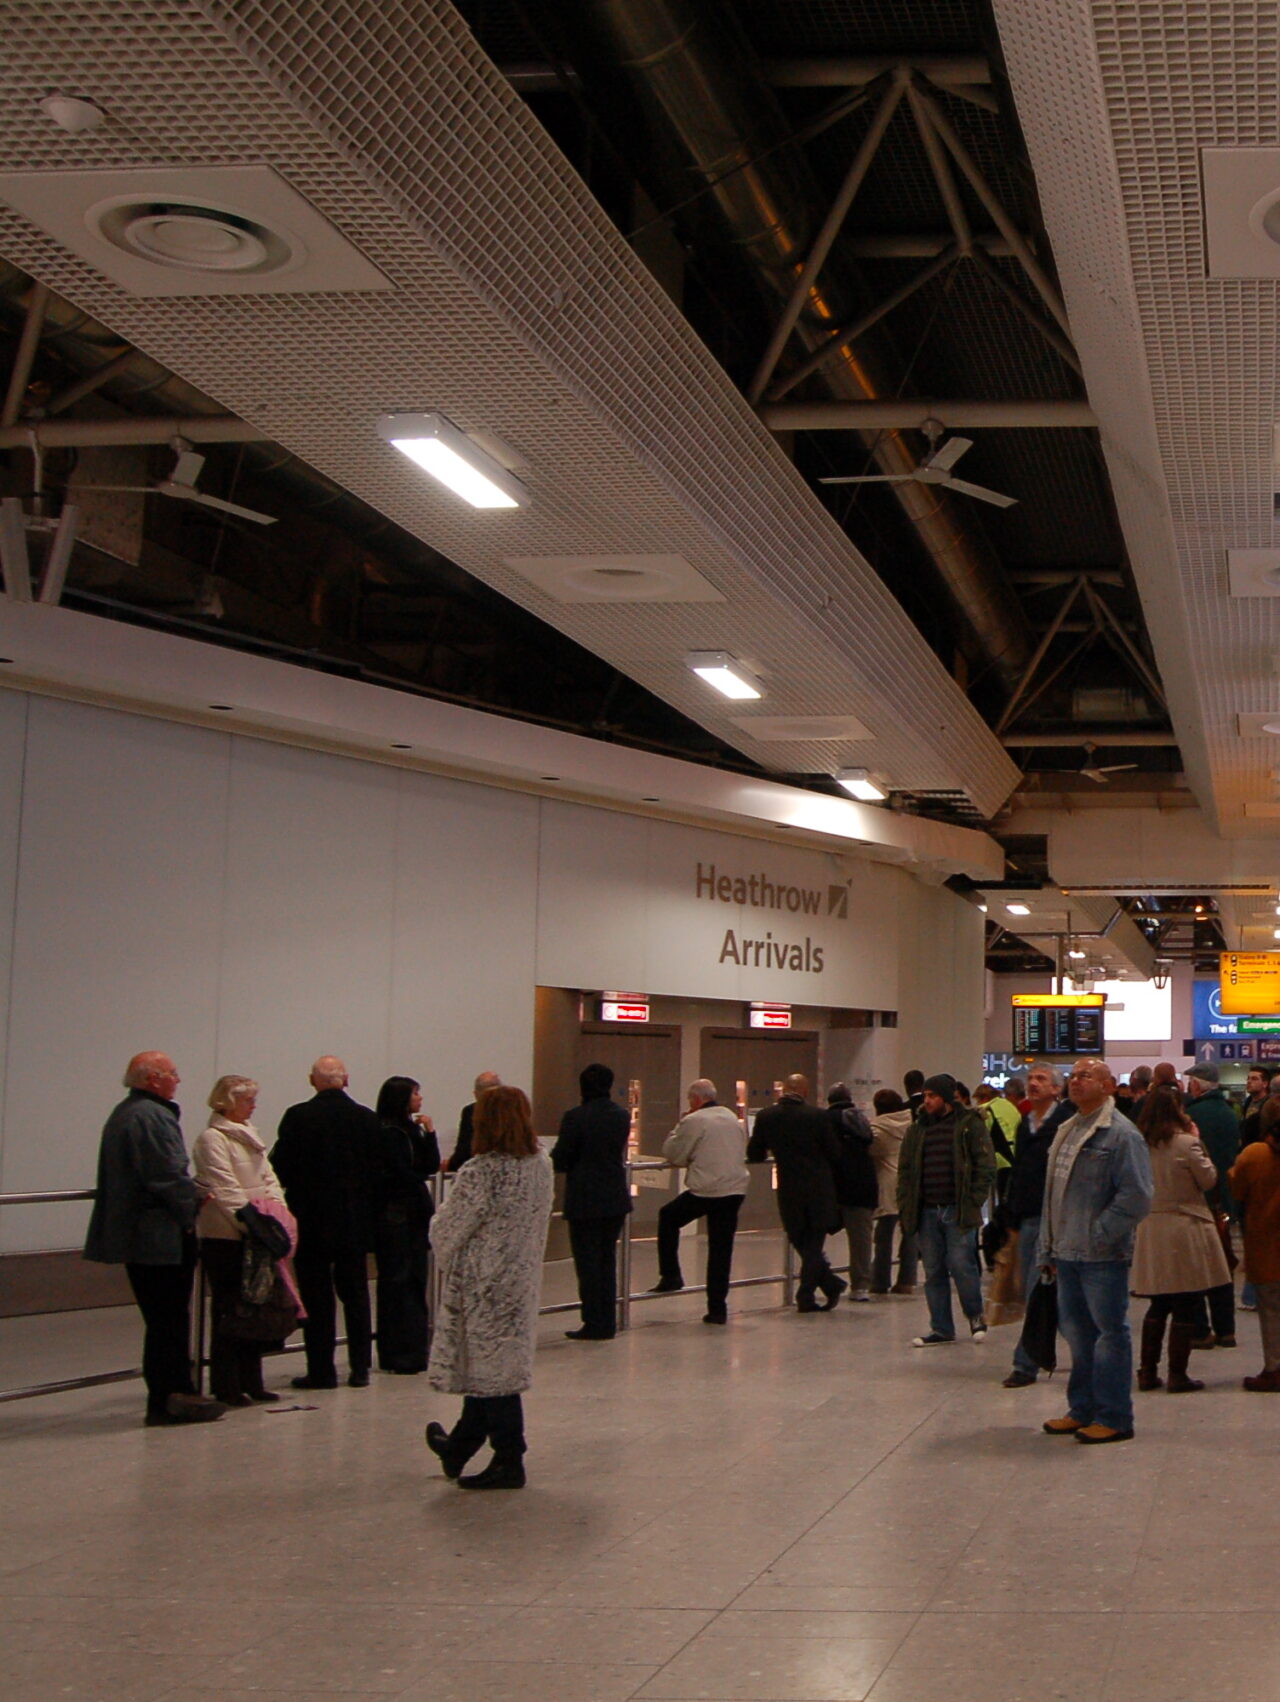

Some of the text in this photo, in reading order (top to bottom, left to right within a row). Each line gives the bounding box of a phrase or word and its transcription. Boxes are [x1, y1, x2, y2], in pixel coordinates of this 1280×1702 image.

[695, 862, 822, 915] Heathrow
[718, 929, 824, 973] Arrivals
[1209, 1023, 1228, 1034] The
